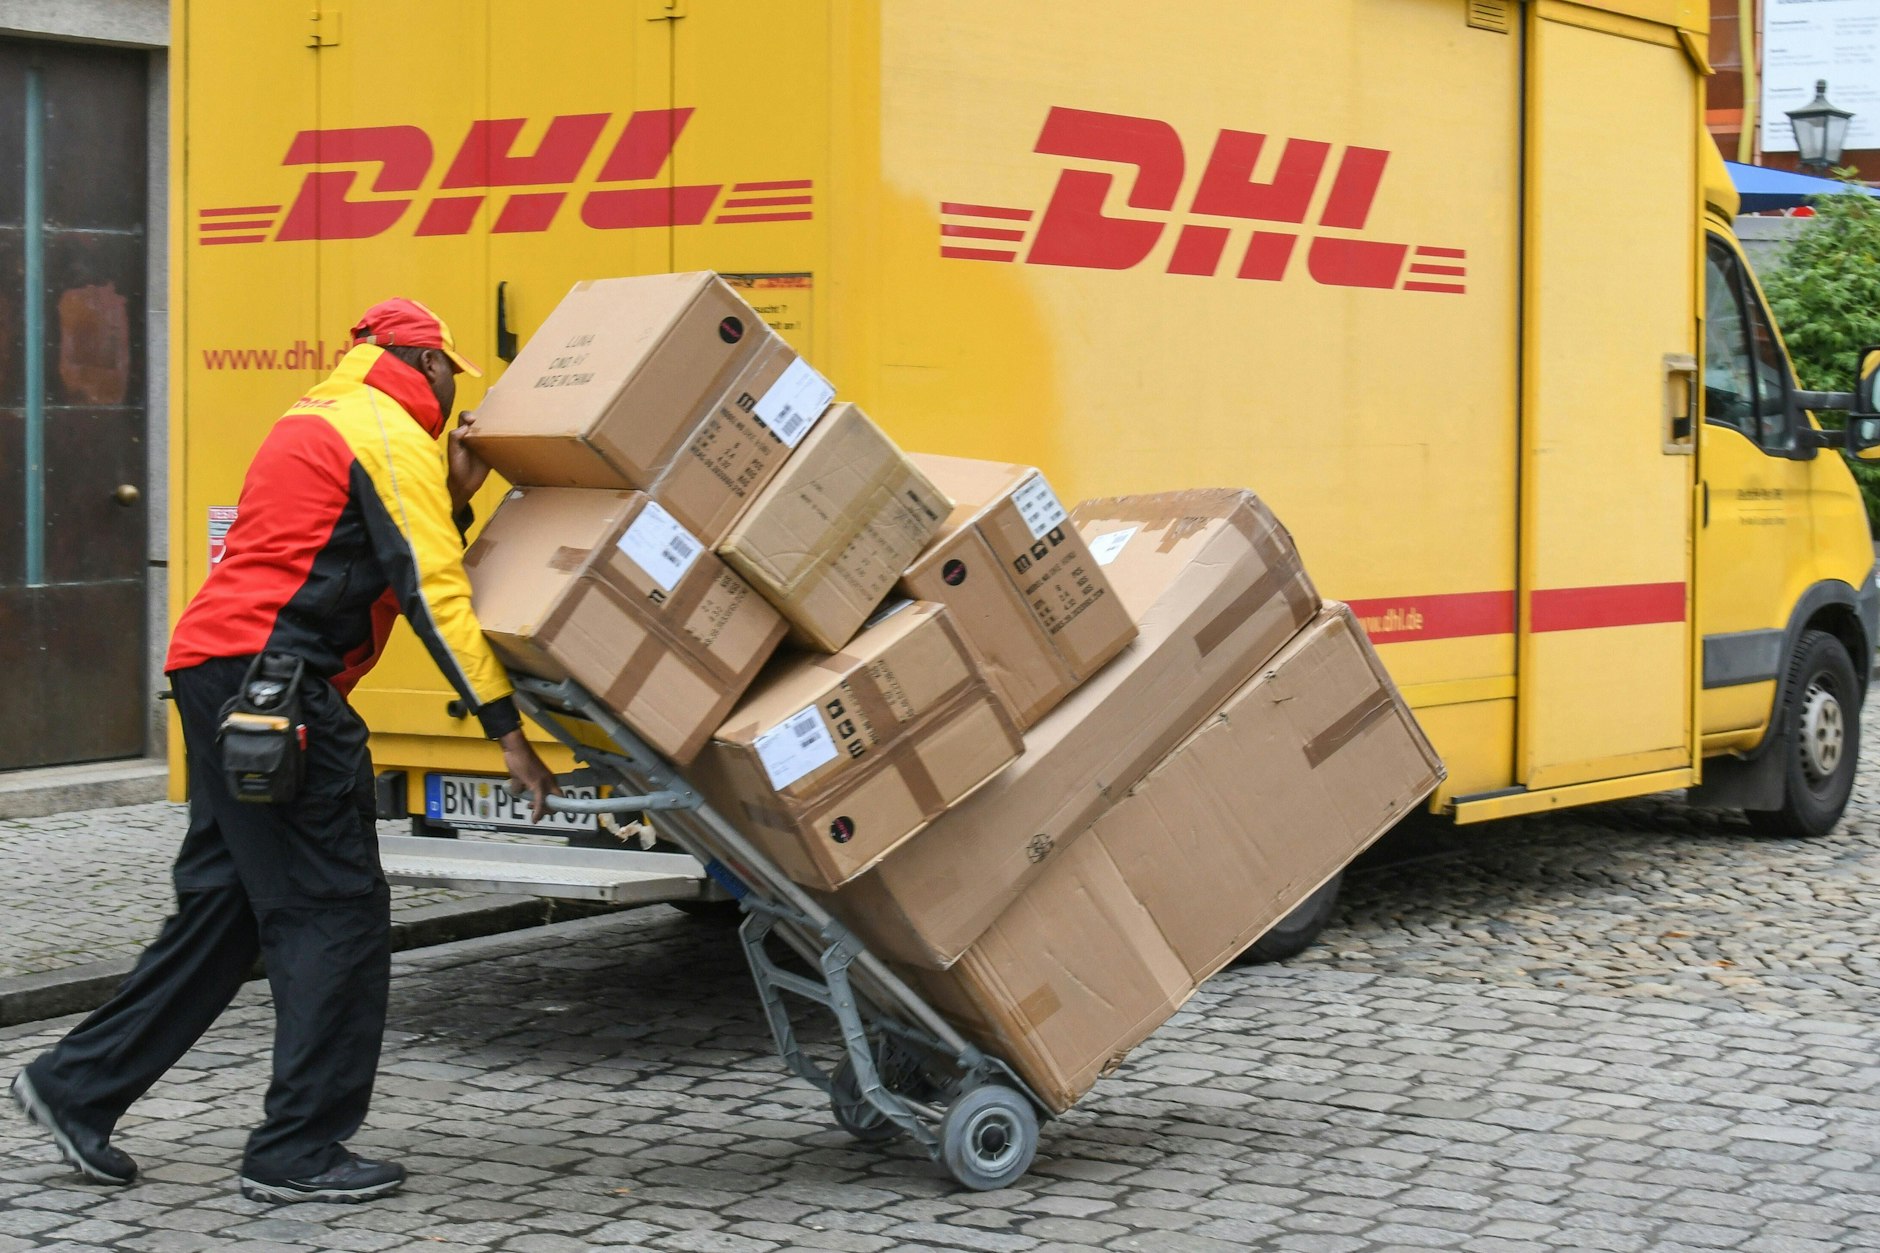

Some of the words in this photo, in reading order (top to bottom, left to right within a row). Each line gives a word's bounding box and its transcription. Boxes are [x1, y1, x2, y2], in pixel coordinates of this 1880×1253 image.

[274, 107, 723, 242] DHL
[1025, 106, 1409, 290] DHL
[203, 341, 350, 370] www.dhl.d
[293, 397, 337, 409] DHL
[444, 781, 475, 816] BN
